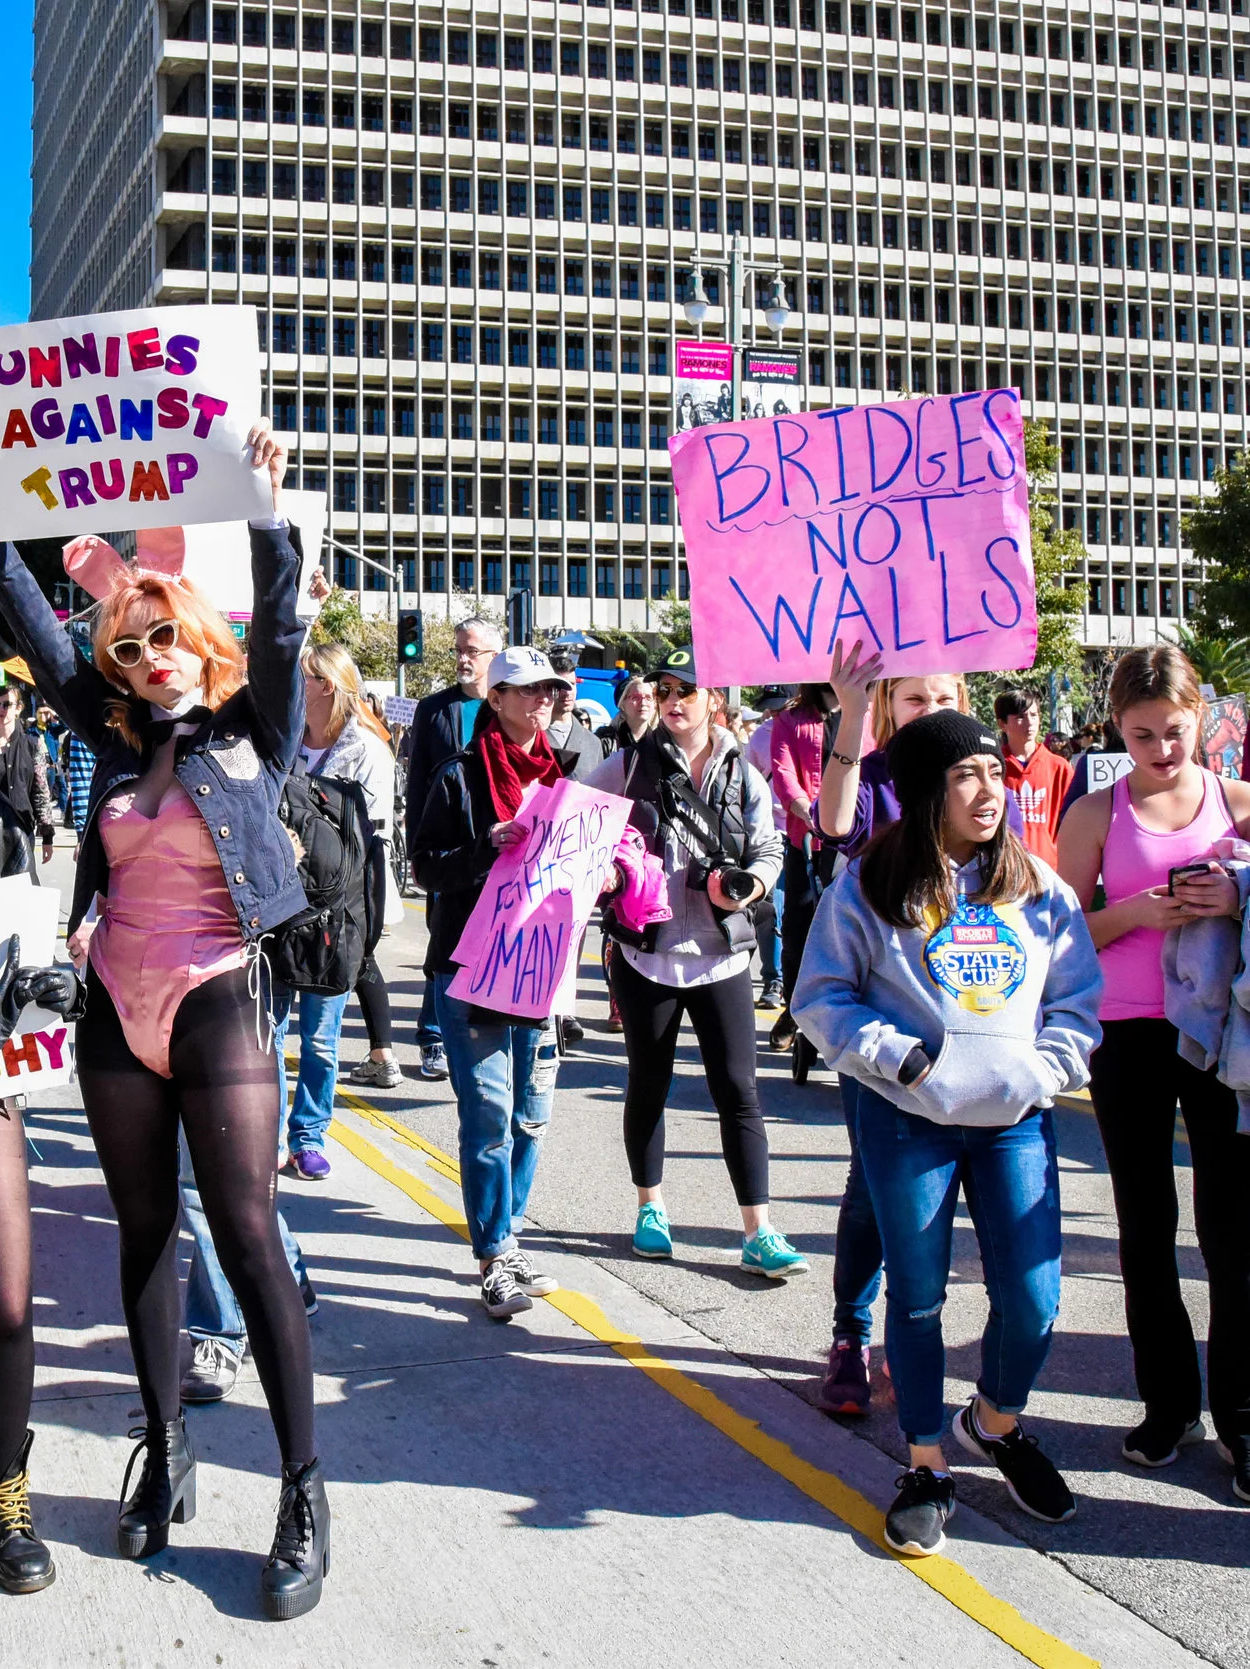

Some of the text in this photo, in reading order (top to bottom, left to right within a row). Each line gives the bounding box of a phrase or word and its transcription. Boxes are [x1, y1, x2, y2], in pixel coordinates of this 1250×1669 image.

[681, 358, 727, 369] RAMONES
[749, 362, 798, 374] RAMONES
[1, 387, 228, 449] AGAINST
[704, 389, 1018, 524] BRIDGES
[20, 452, 199, 511] TRUMP
[806, 493, 965, 575] NOT
[728, 536, 1022, 662] WALLS
[526, 650, 546, 667] LA
[1093, 759, 1122, 783] BY
[524, 803, 609, 865] OMEN'S
[1022, 810, 1047, 824] idas
[467, 922, 564, 1006] UMAN
[943, 950, 1012, 972] STATE
[958, 968, 999, 986] CUP
